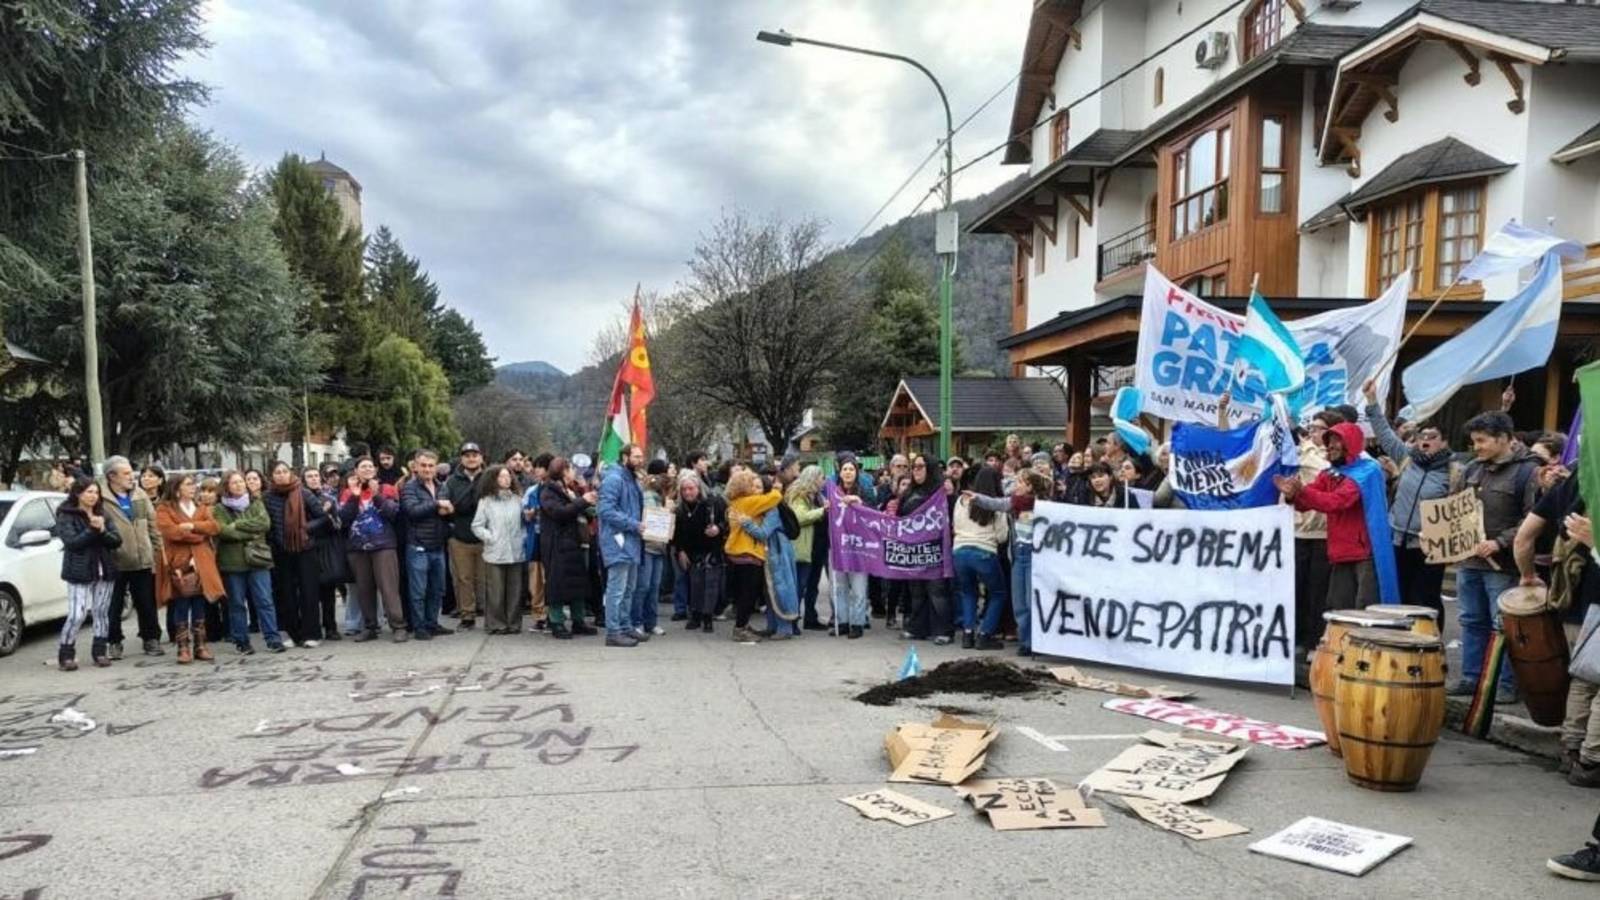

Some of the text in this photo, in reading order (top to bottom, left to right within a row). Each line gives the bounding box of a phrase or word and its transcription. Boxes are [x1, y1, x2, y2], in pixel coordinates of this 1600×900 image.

[1151, 391, 1175, 406] SAN
[1184, 399, 1243, 418] MARIN
[841, 533, 864, 547] PTS
[1031, 516, 1118, 560] CORTE
[464, 726, 592, 749] NO
